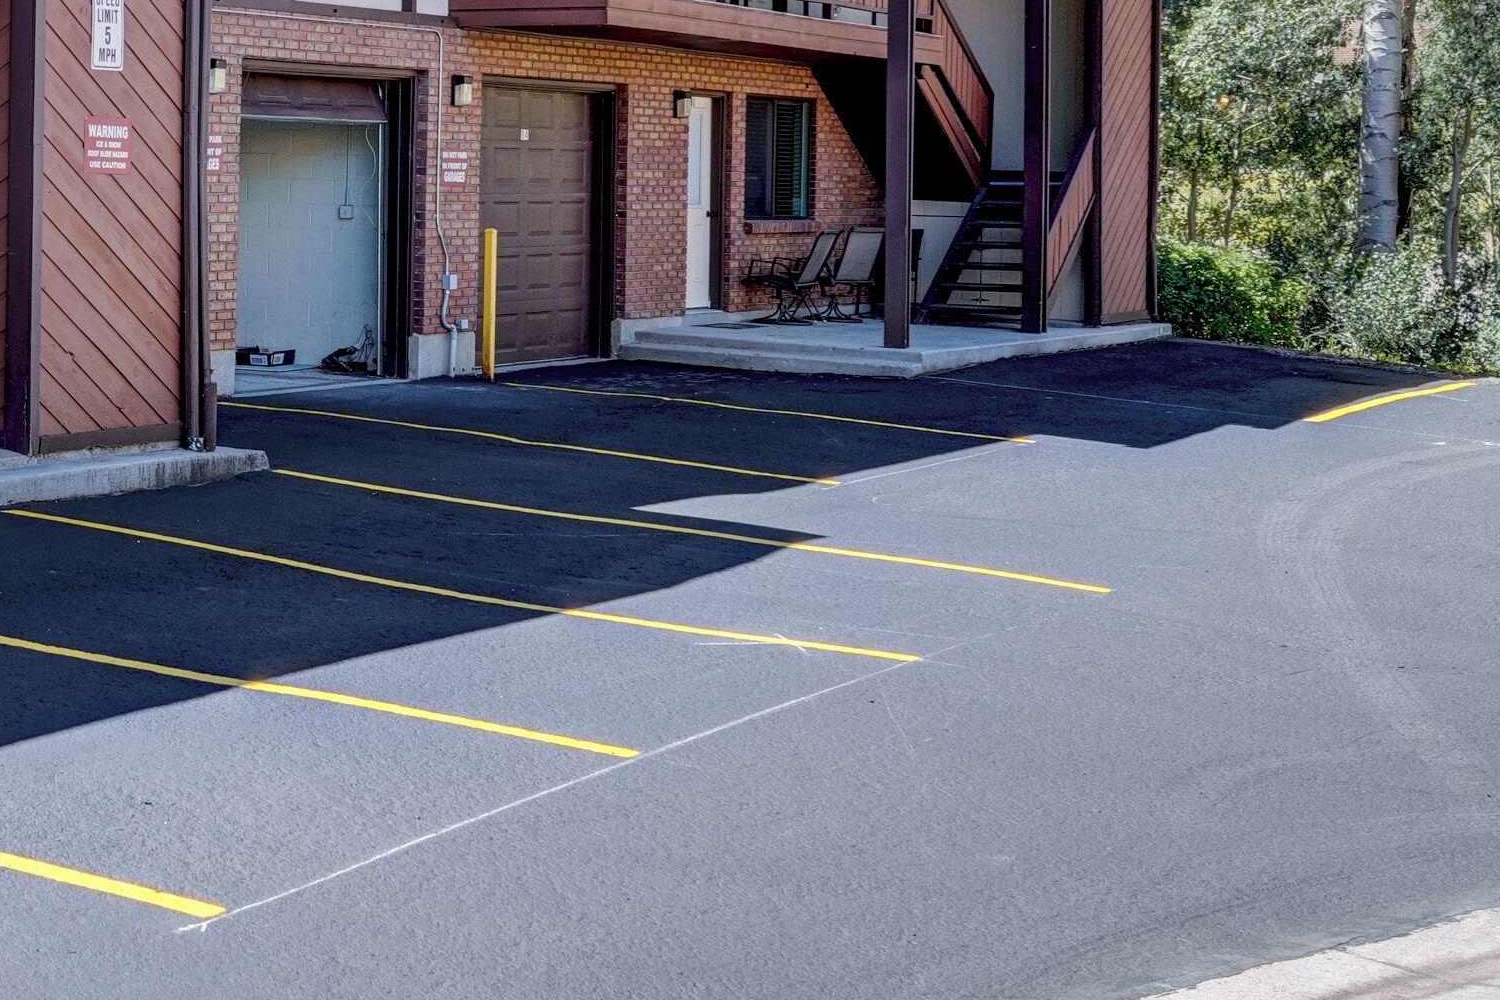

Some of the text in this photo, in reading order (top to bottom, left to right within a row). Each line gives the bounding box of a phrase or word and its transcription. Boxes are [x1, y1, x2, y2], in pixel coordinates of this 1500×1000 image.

[97, 8, 119, 24] LIMIT
[104, 26, 111, 45] 5
[98, 47, 117, 63] MPH
[88, 123, 129, 139] WARNING
[442, 151, 449, 159] DO
[89, 160, 127, 169] USE CAUTION
[448, 162, 461, 170] FRONT
[444, 171, 465, 182] GARAGES
